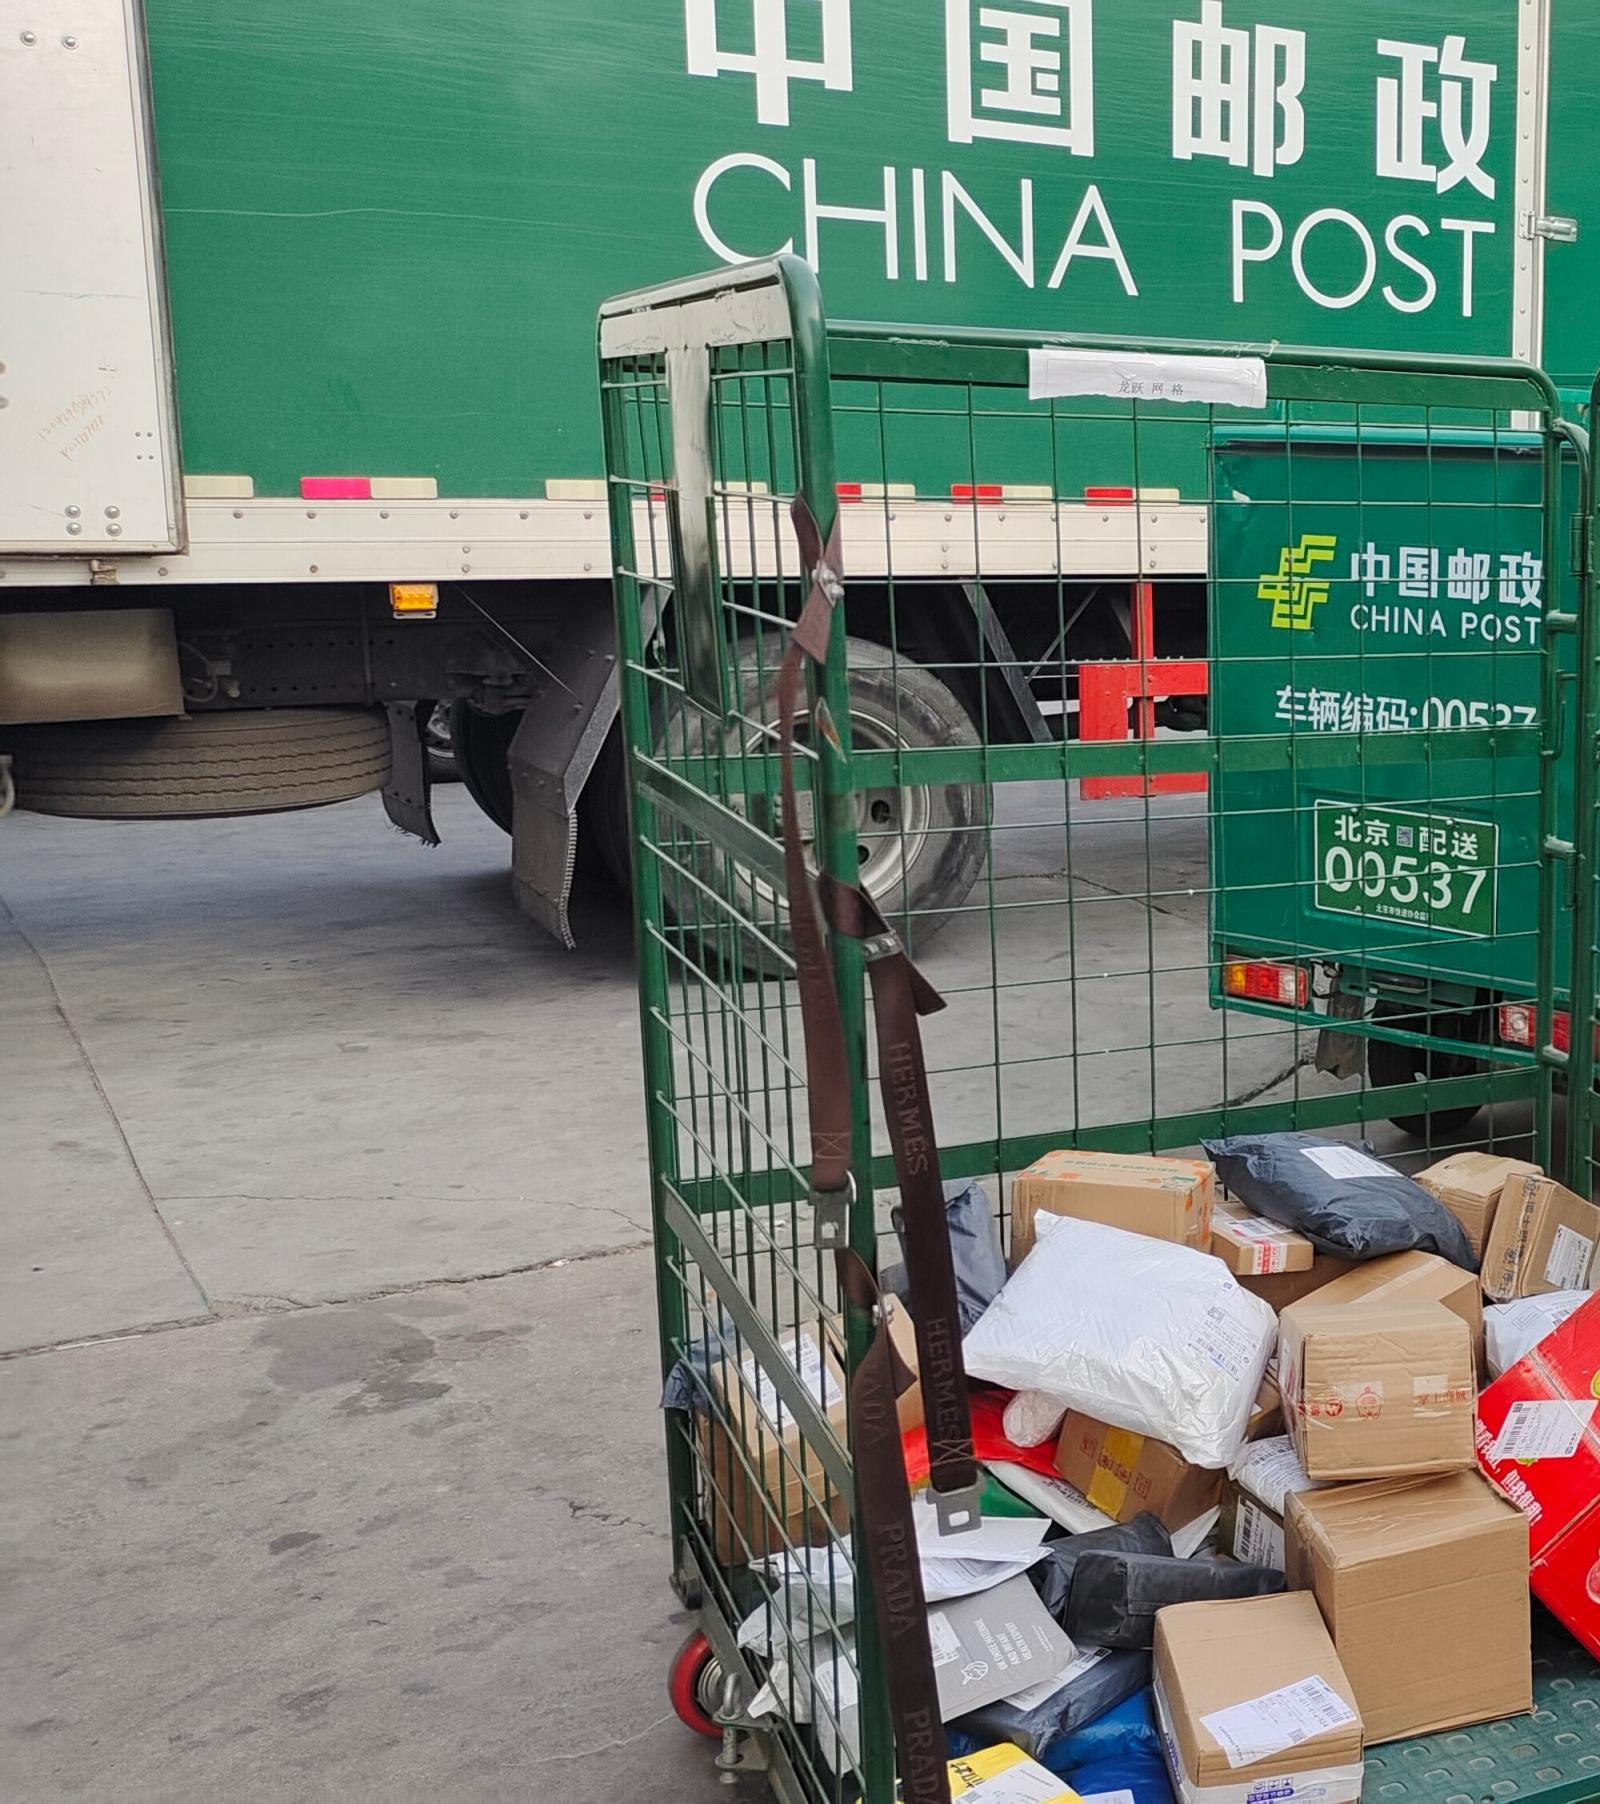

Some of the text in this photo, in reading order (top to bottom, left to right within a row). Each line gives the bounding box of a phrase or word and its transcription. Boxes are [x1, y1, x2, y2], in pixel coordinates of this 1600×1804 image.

[686, 0, 1498, 200] 中国邮政
[693, 153, 1496, 318] CHINA POST
[1349, 541, 1542, 610] 中国邮政
[1350, 604, 1542, 645] CHINA POST
[1324, 845, 1488, 914] 00537
[876, 1520, 917, 1640] PRADA
